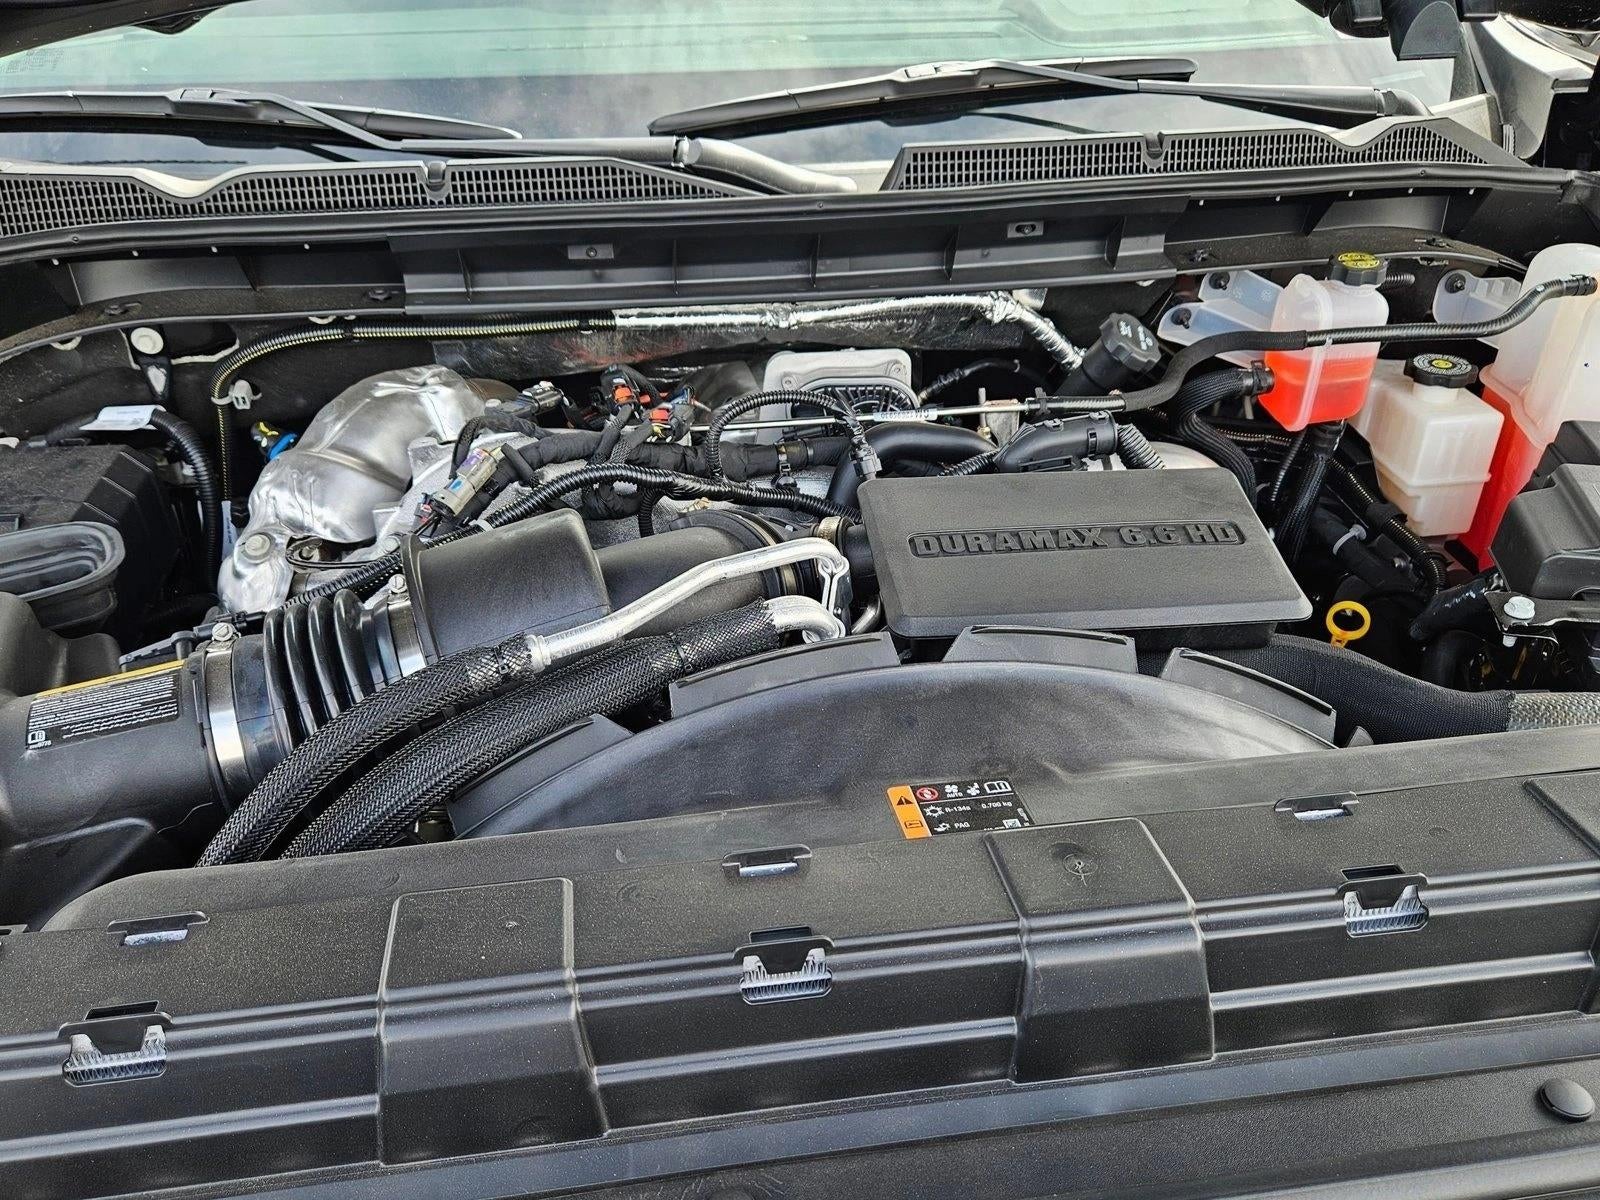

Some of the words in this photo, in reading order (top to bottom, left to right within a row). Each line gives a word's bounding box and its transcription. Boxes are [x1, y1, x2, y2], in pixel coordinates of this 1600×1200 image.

[912, 527, 1108, 556] DURAMAX
[1118, 525, 1182, 548] 6.6
[1184, 523, 1240, 544] HD
[945, 805, 971, 813] R-134a
